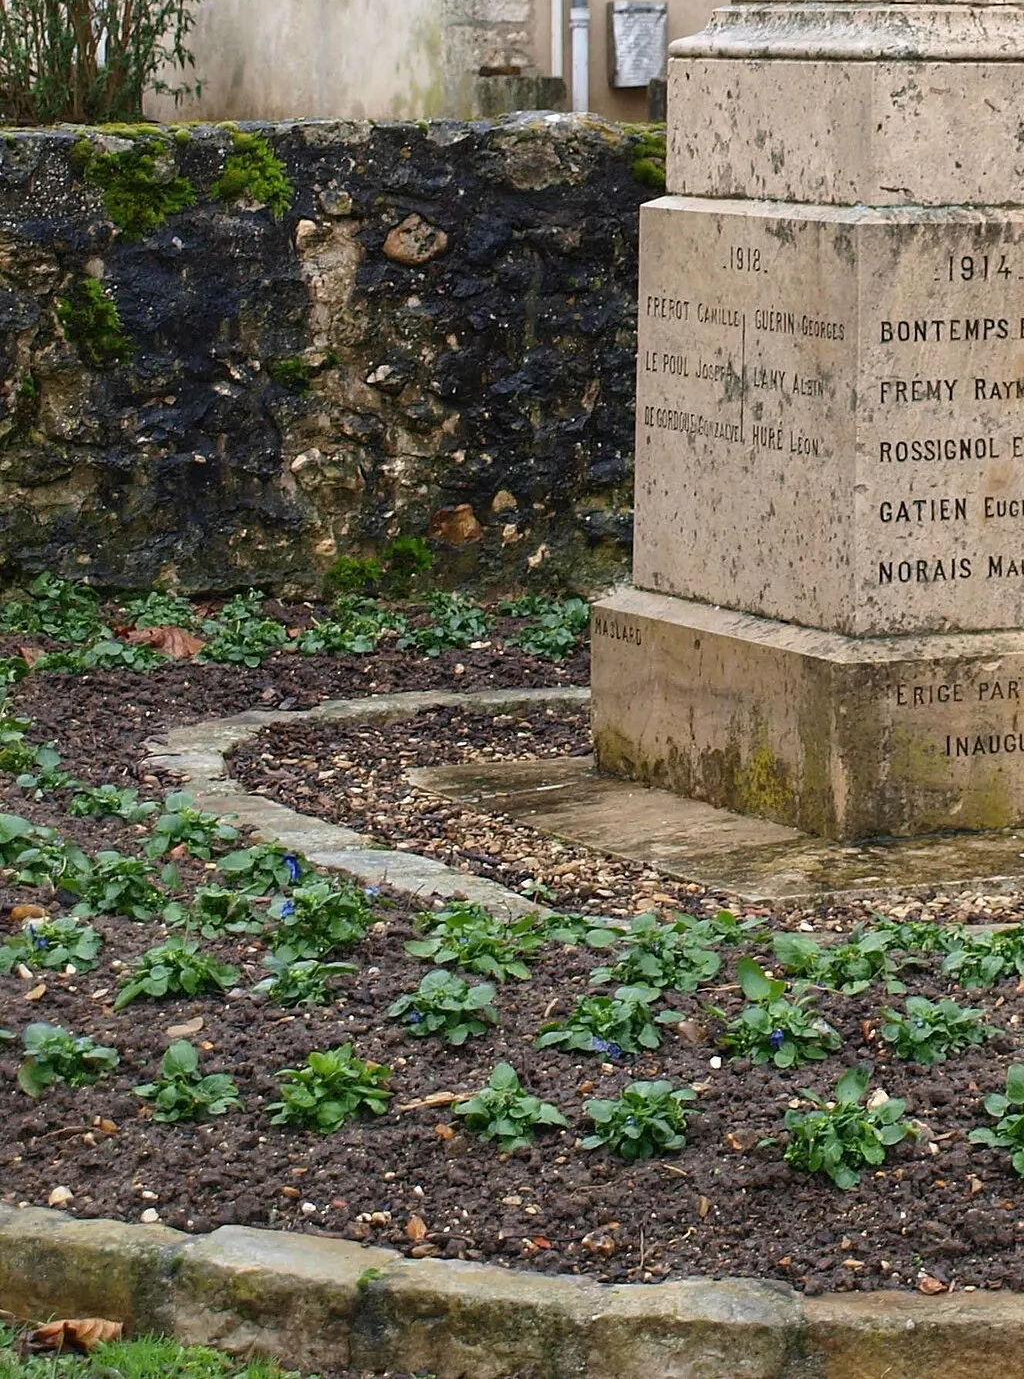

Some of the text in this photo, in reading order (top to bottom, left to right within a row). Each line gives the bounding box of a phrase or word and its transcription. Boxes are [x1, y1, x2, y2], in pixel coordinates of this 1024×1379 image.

[698, 303, 740, 327] CAMILLE
[754, 304, 846, 341] GUÉRIN GEORGES
[880, 318, 1009, 343] BONTEMPS
[646, 351, 734, 382] LE POUL JOSEPH
[793, 374, 824, 398] ALBIN
[752, 422, 821, 458] HURÉ LÉON
[880, 437, 1000, 463] ROSSIGNOL
[879, 498, 967, 523] GATIEN
[878, 559, 972, 585] NORAIS
[978, 680, 1020, 701] PAR
